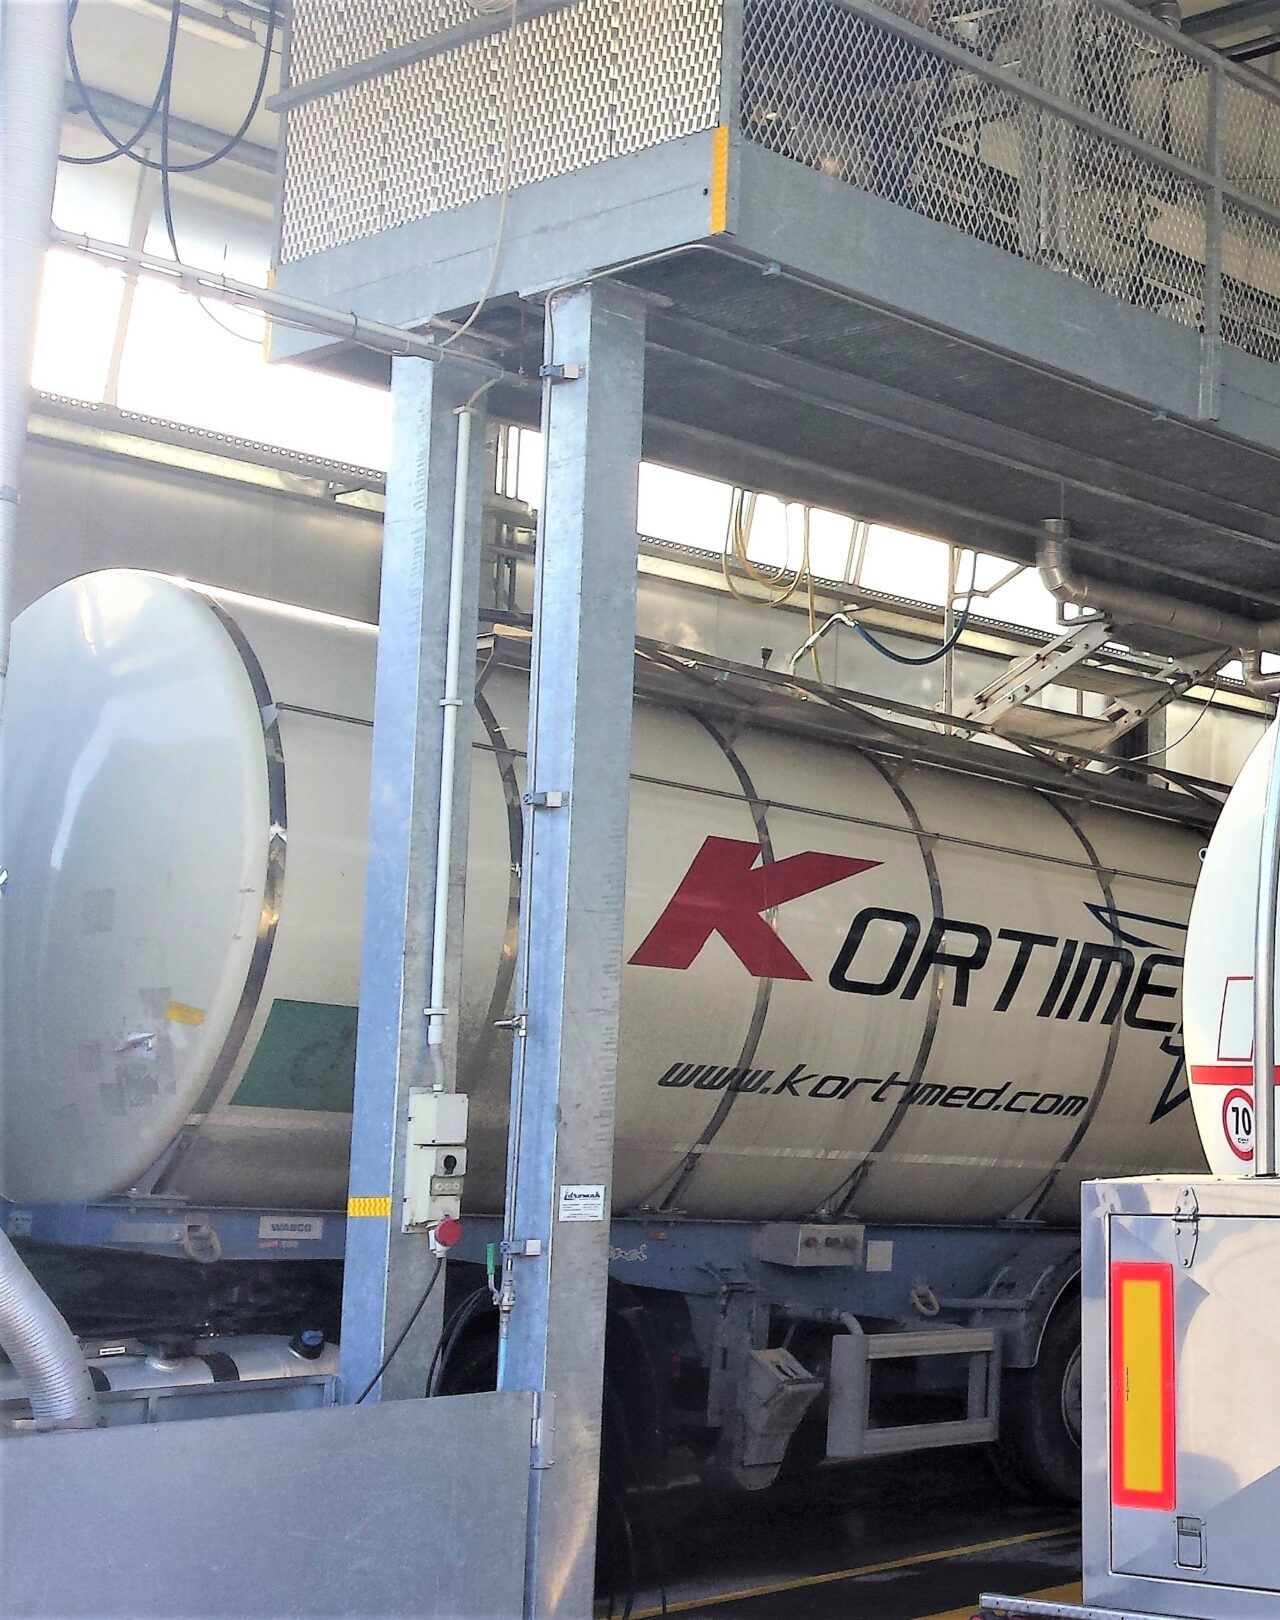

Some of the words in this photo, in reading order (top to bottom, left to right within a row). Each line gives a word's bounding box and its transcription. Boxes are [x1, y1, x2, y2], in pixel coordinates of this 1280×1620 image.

[627, 835, 1185, 1033] KORTIME
[657, 1062, 1089, 1117] www.kortimed.com
[1231, 1106, 1252, 1136] 70
